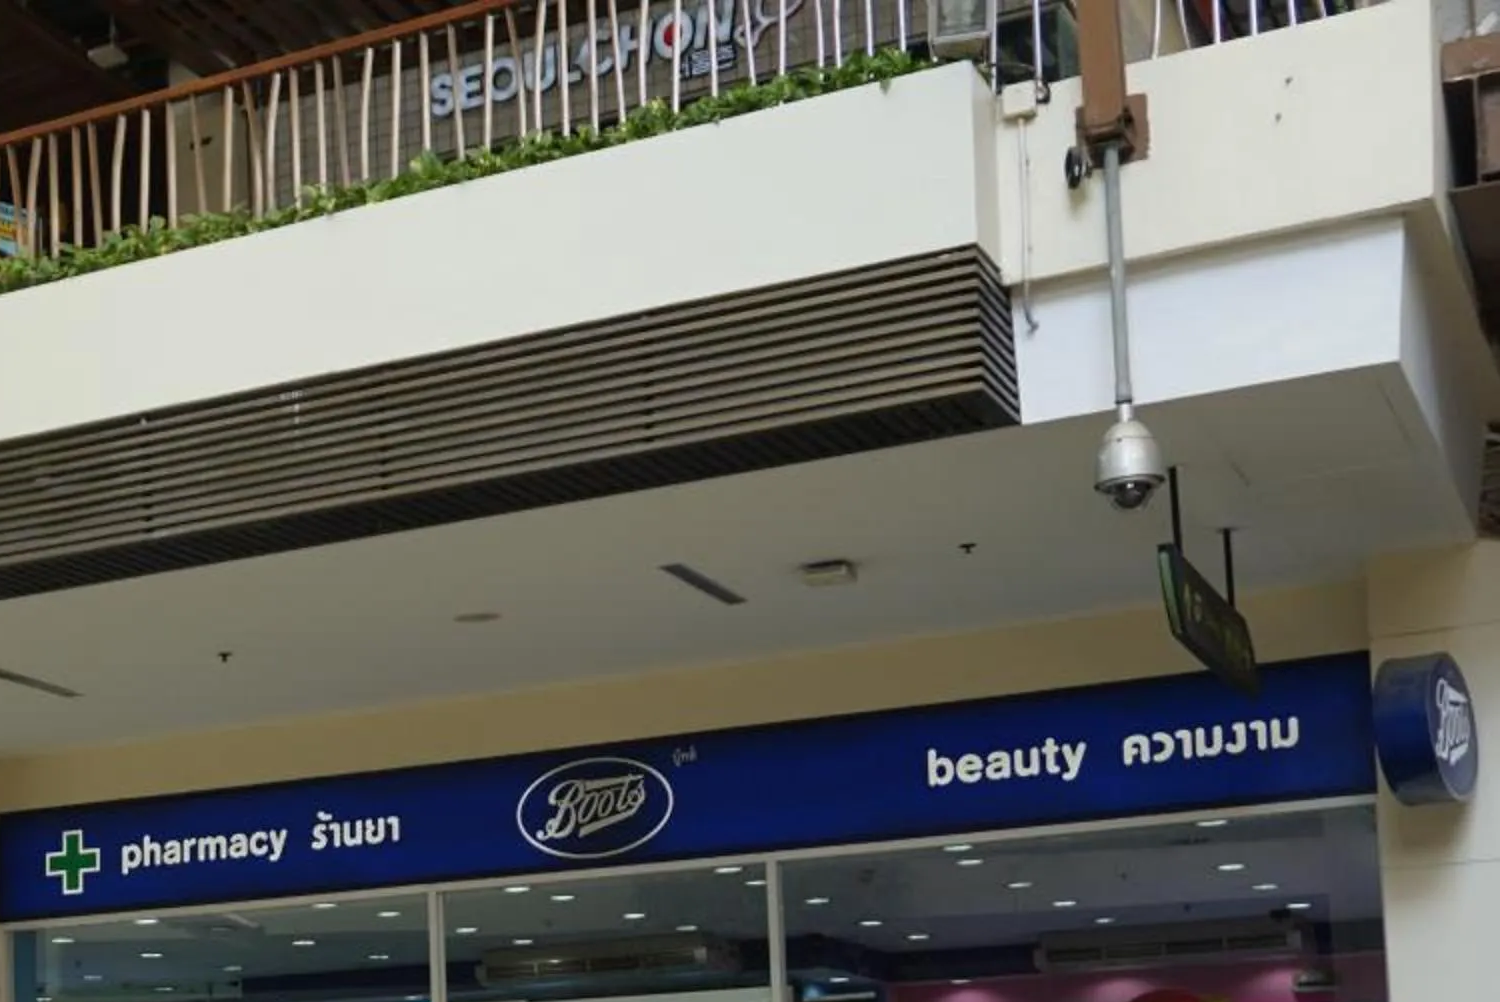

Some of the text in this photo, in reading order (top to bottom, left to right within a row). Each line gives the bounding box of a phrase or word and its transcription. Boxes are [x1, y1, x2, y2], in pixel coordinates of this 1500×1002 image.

[1122, 716, 1300, 767] ความงาม
[1435, 677, 1471, 766] Boots
[927, 736, 1087, 787] beauty
[311, 811, 401, 851] ร้านยา
[536, 773, 647, 841] Boots
[121, 828, 288, 875] pharmacy
